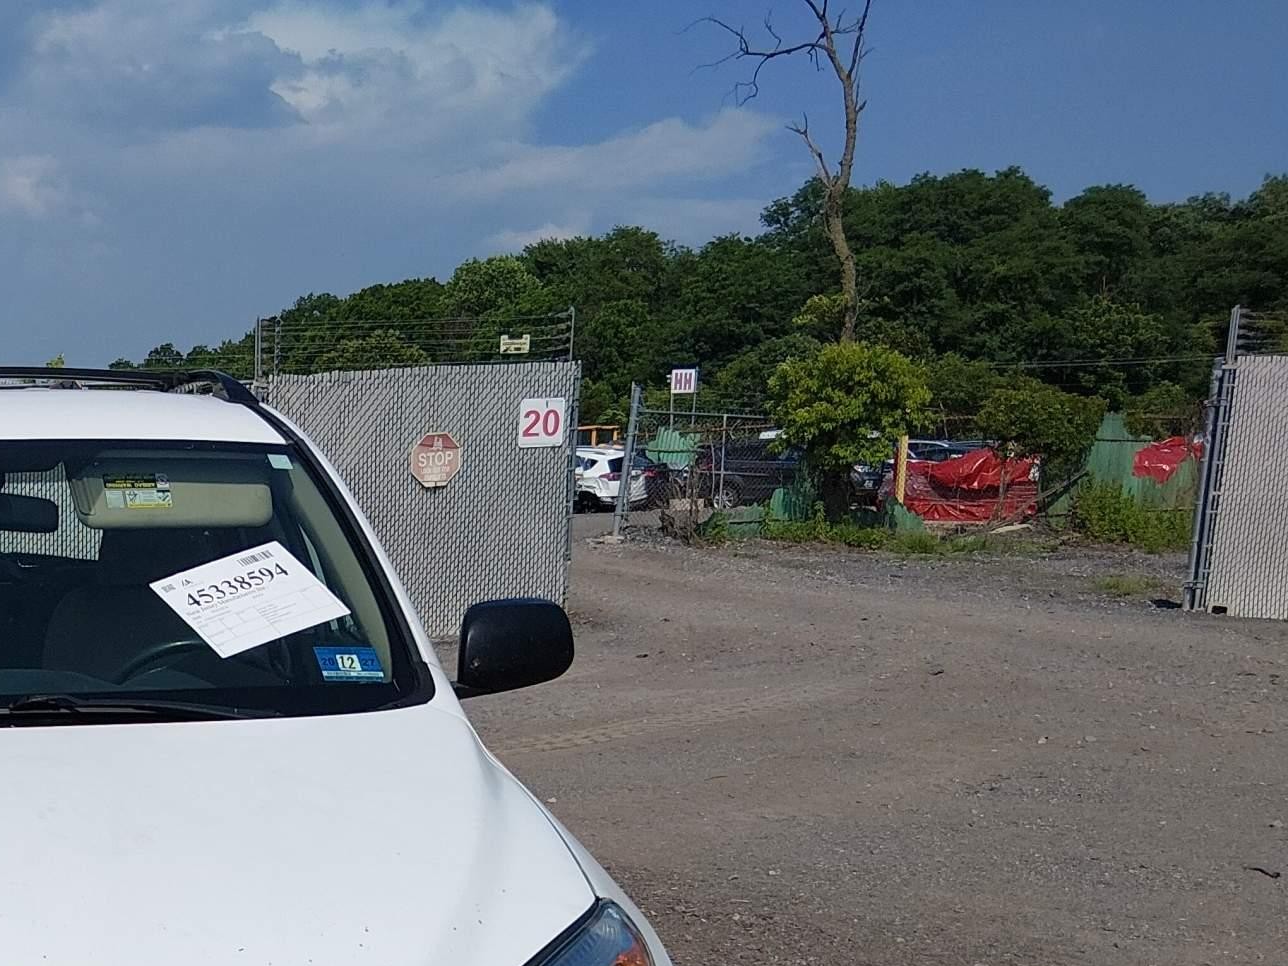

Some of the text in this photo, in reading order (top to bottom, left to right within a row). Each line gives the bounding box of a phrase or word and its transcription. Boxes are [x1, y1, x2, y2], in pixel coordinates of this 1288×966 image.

[674, 372, 692, 390] HH
[522, 409, 560, 437] 20
[418, 451, 453, 467] STOP
[187, 562, 289, 607] 45338594
[321, 655, 376, 670] 20 12 27
